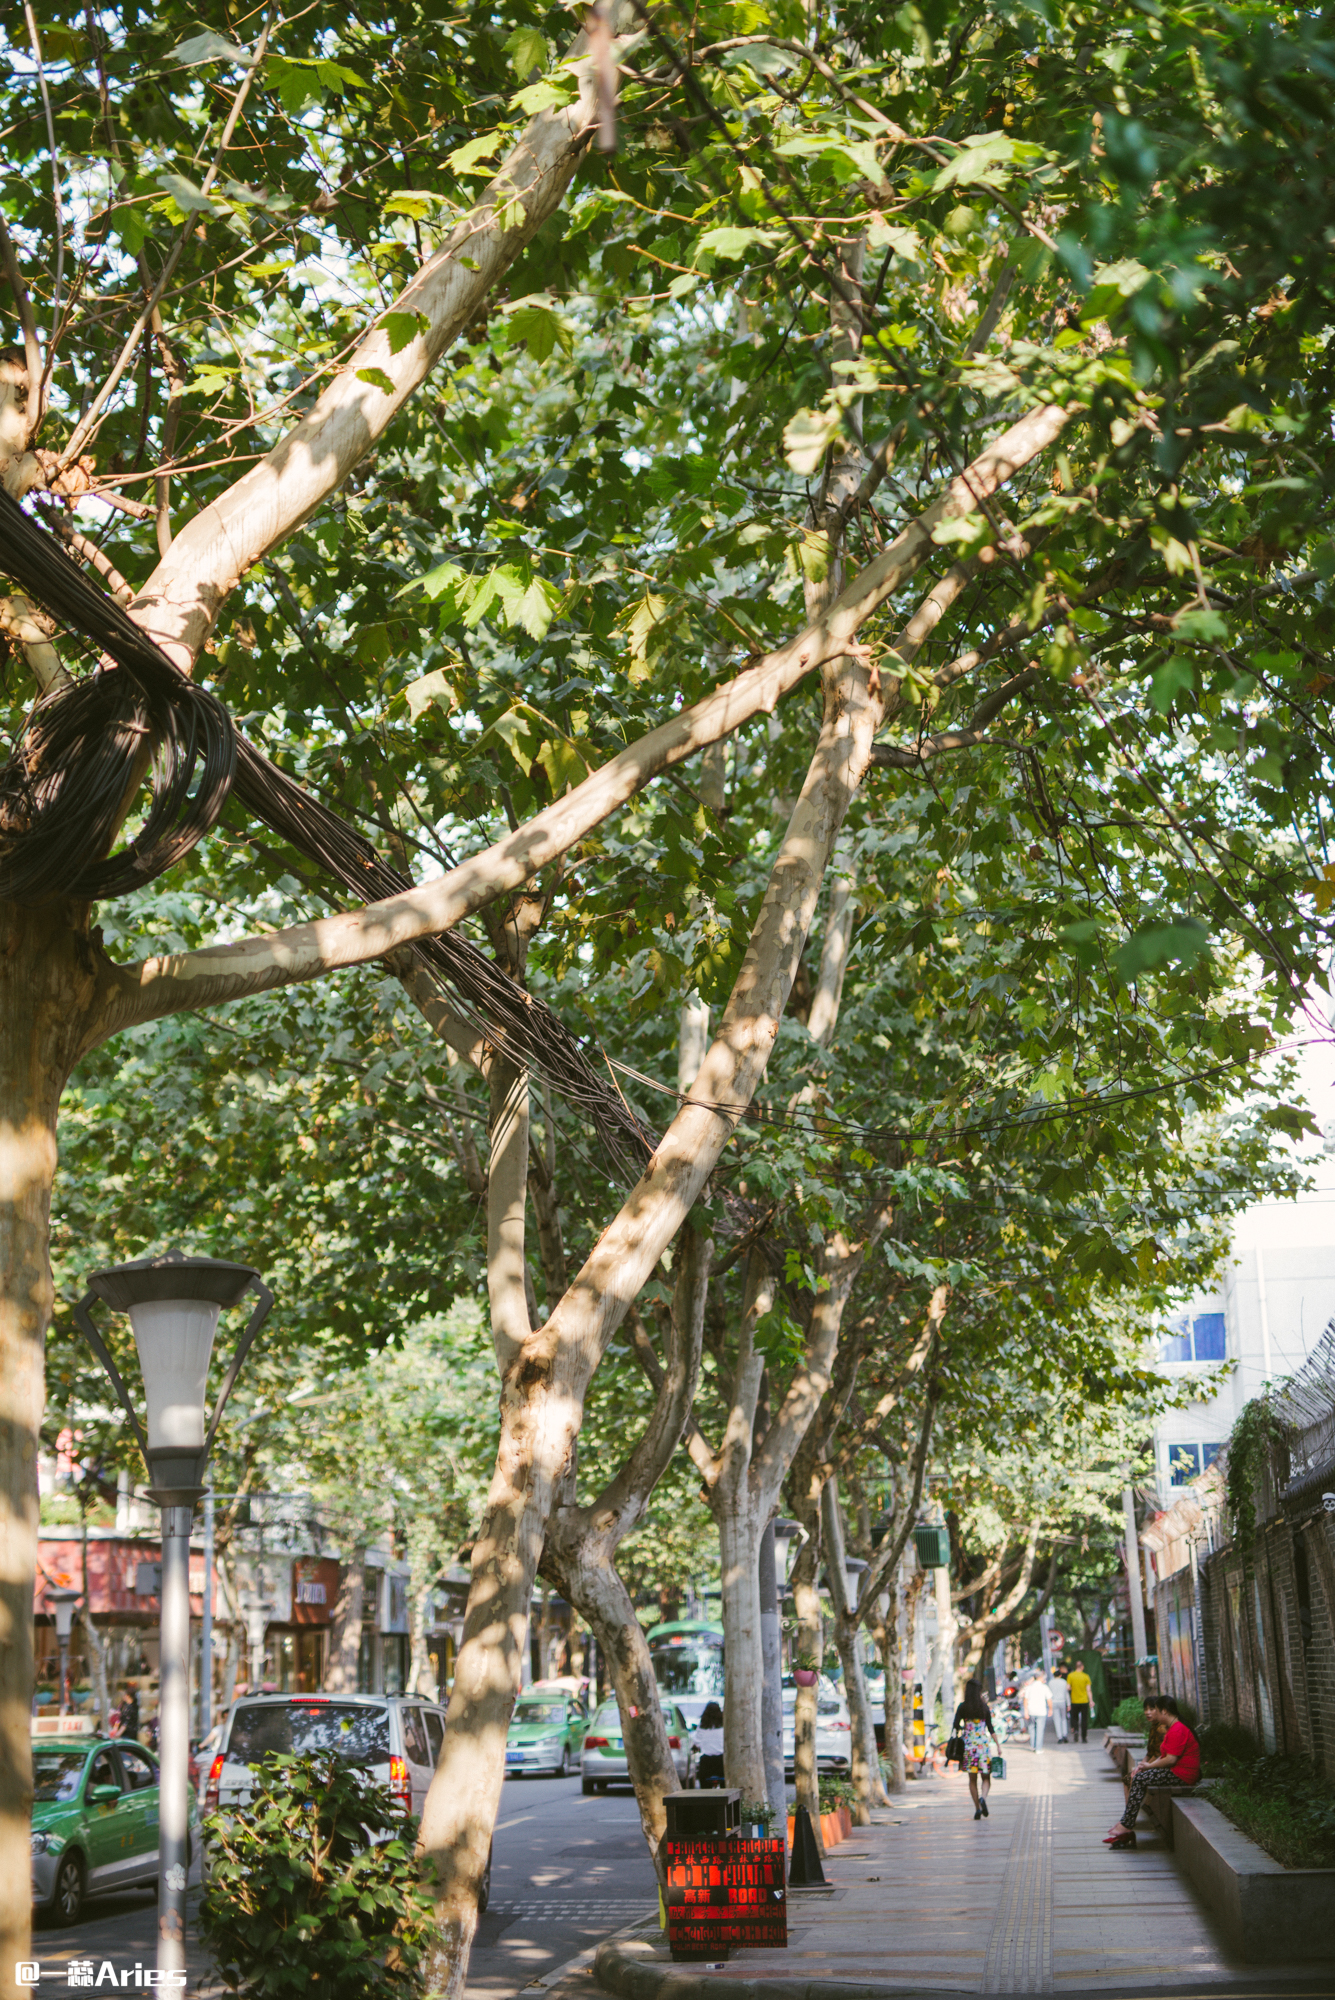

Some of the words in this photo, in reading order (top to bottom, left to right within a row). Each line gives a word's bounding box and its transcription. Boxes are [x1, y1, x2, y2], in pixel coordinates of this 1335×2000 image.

[62, 1721, 83, 1731] TAXI
[673, 1854, 724, 1866] 玉林西路
[728, 1854, 774, 1864] 玉林西路
[683, 1888, 711, 1904] 高新
[728, 1888, 767, 1904] ROAD
